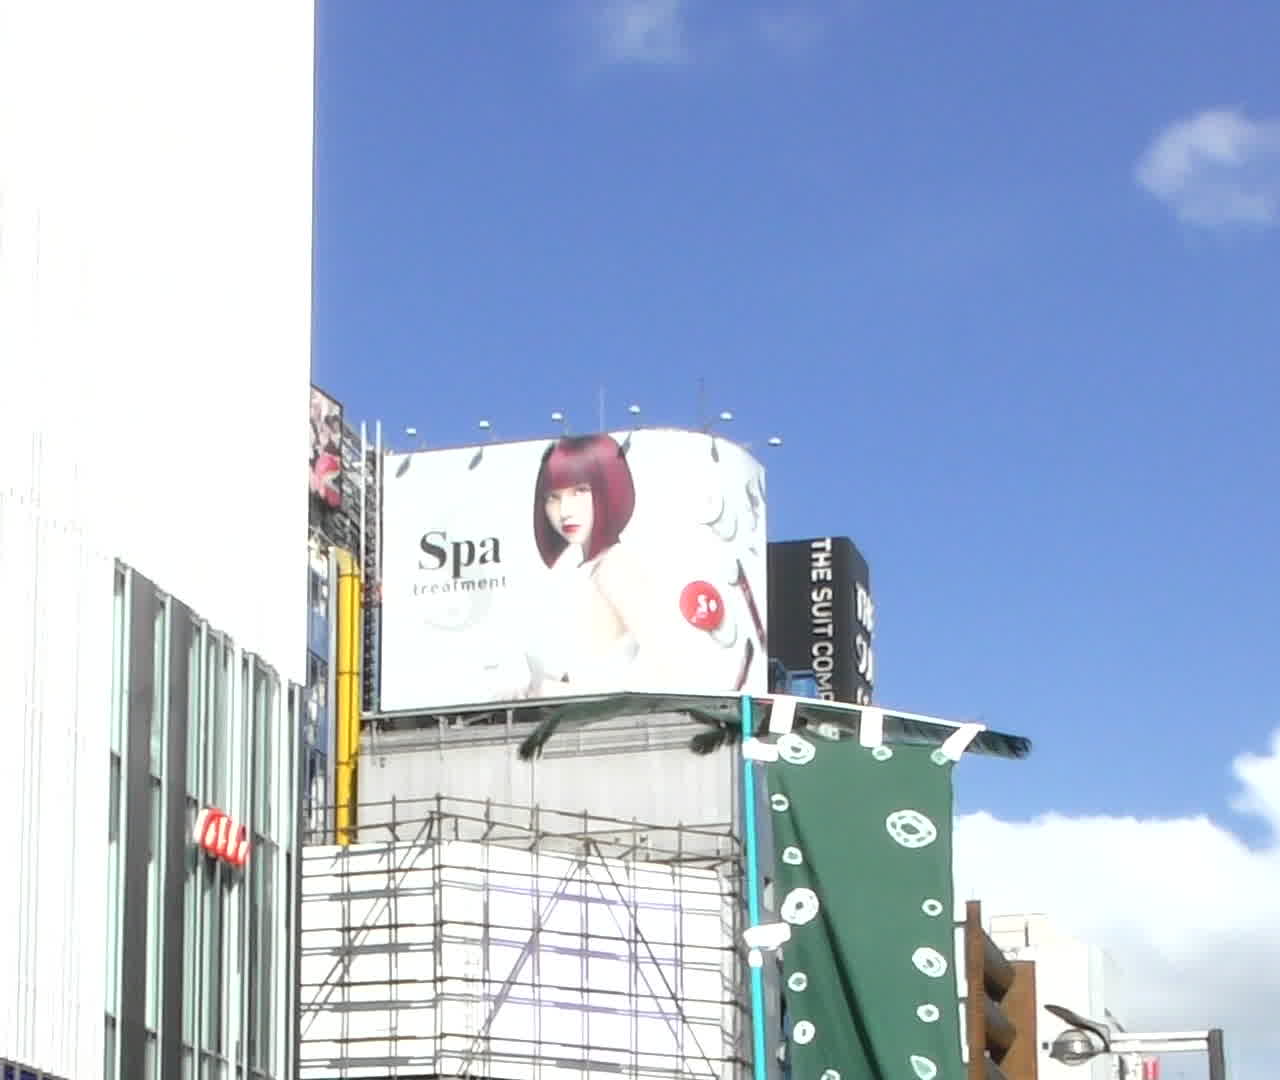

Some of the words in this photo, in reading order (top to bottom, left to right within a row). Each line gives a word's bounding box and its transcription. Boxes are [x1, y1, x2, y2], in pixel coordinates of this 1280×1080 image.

[418, 531, 501, 579] Spa
[811, 538, 832, 582] THE
[412, 575, 507, 597] treatment
[811, 587, 833, 637] SUIT
